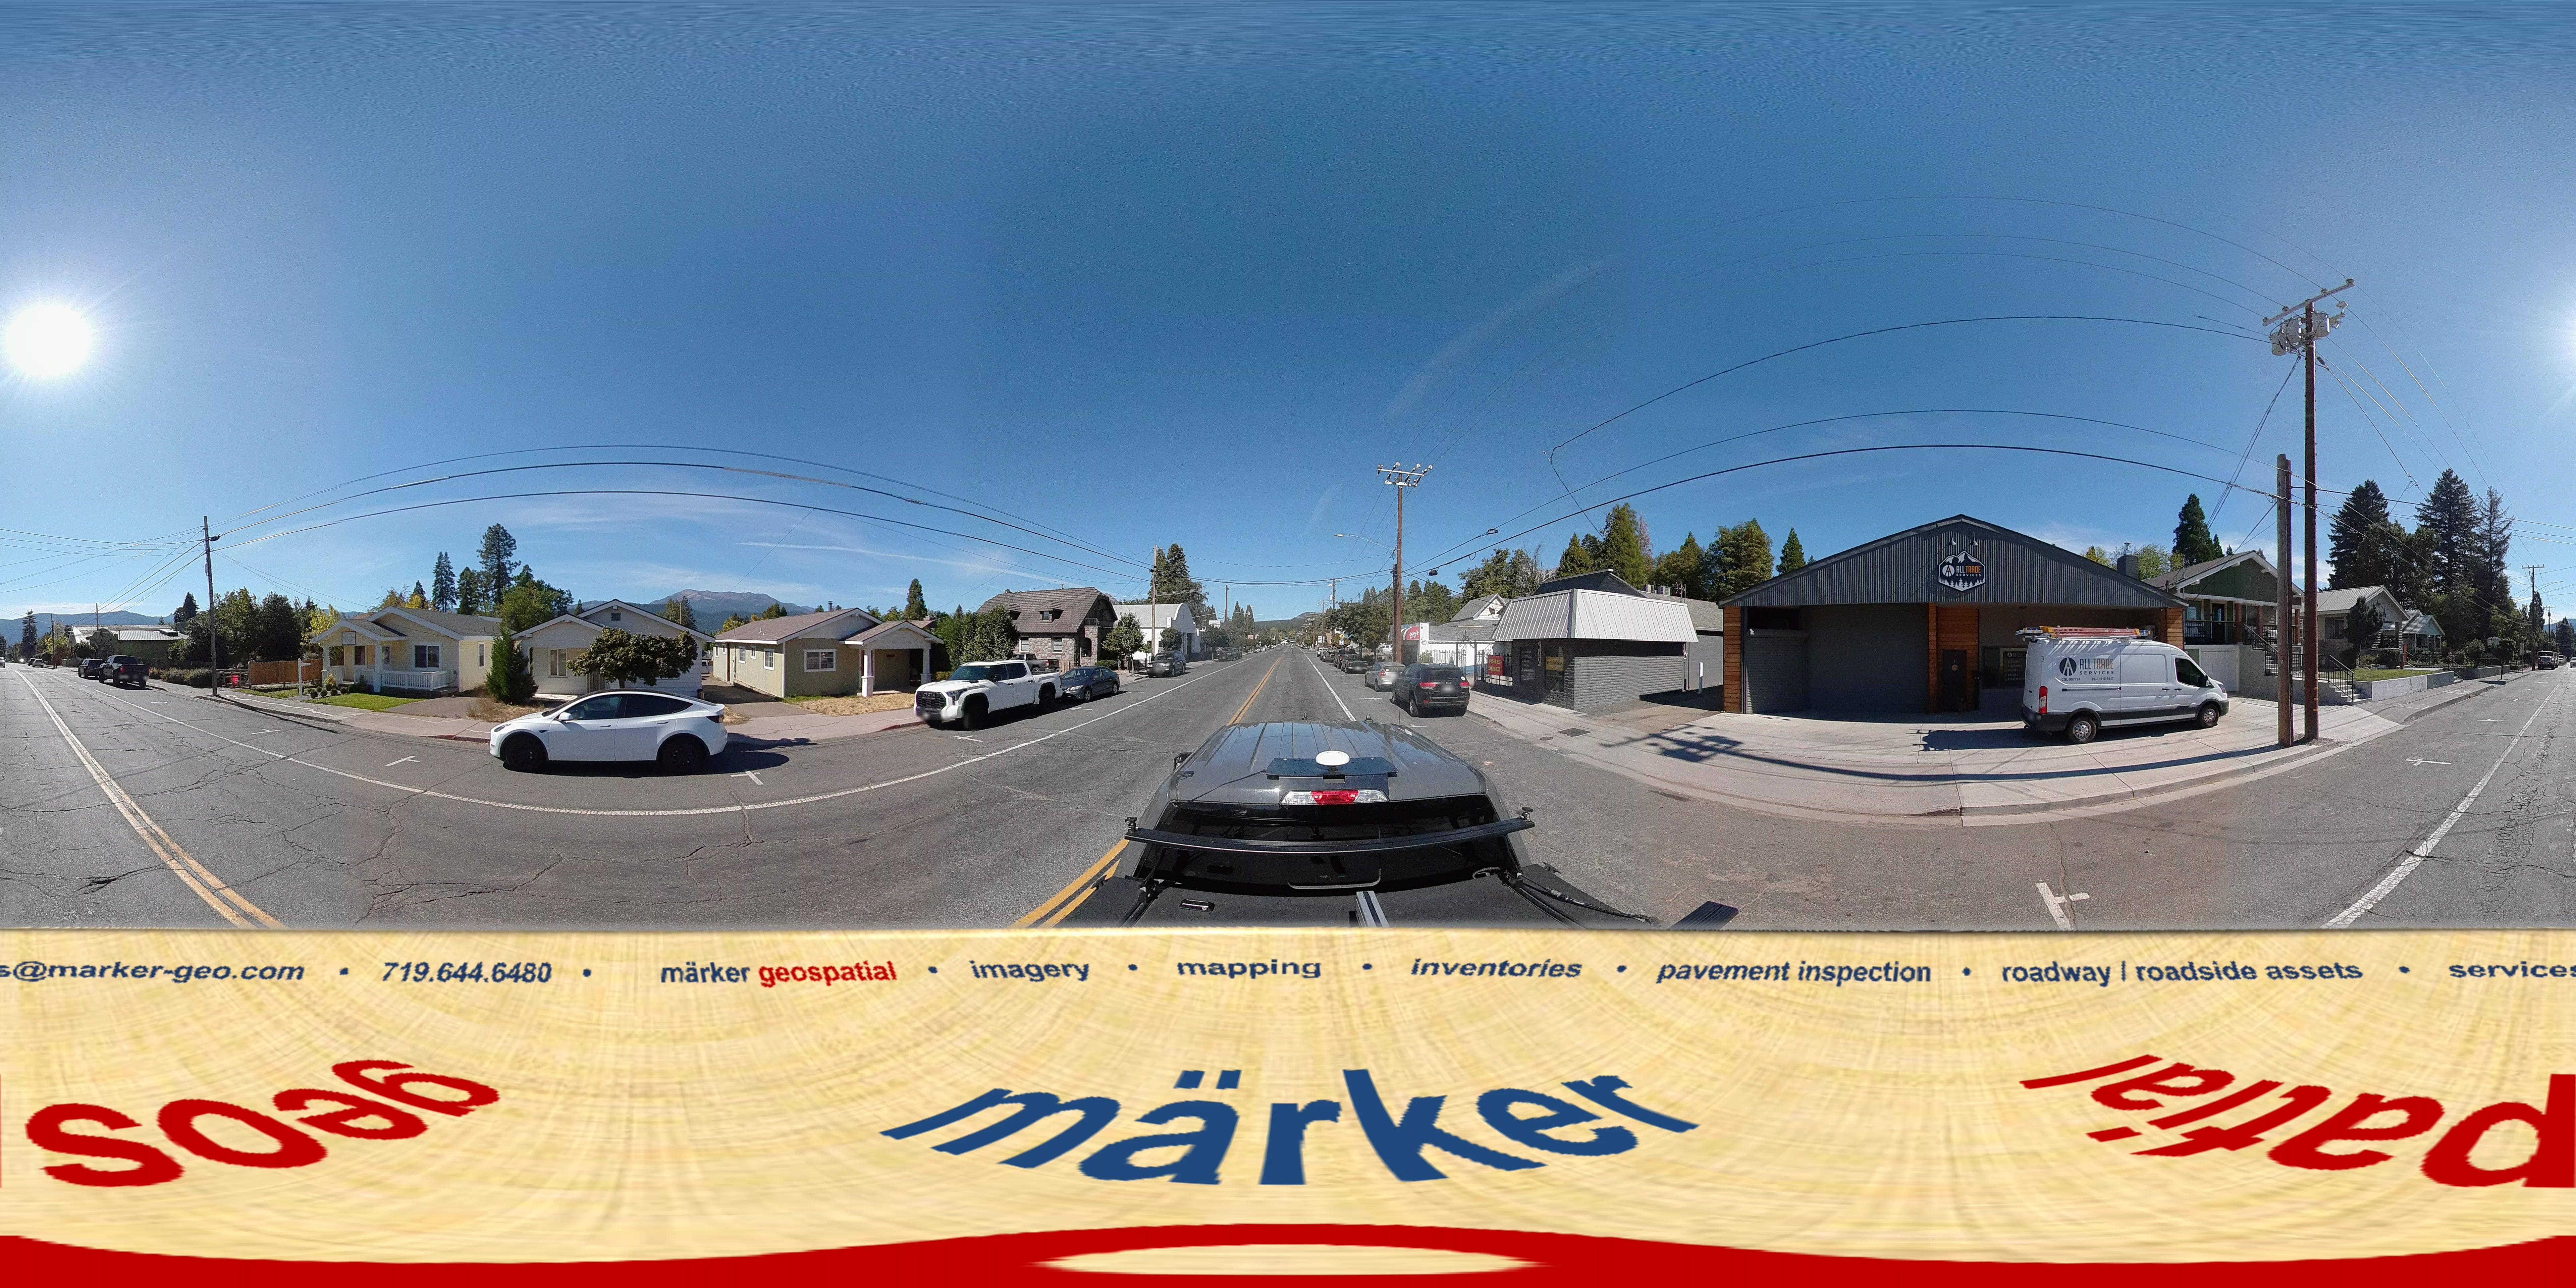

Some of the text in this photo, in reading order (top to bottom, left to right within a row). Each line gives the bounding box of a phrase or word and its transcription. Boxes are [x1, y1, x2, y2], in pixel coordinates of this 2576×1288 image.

[1409, 630, 1419, 639] gigi's
[2080, 658, 2114, 669] ALL TRADE
